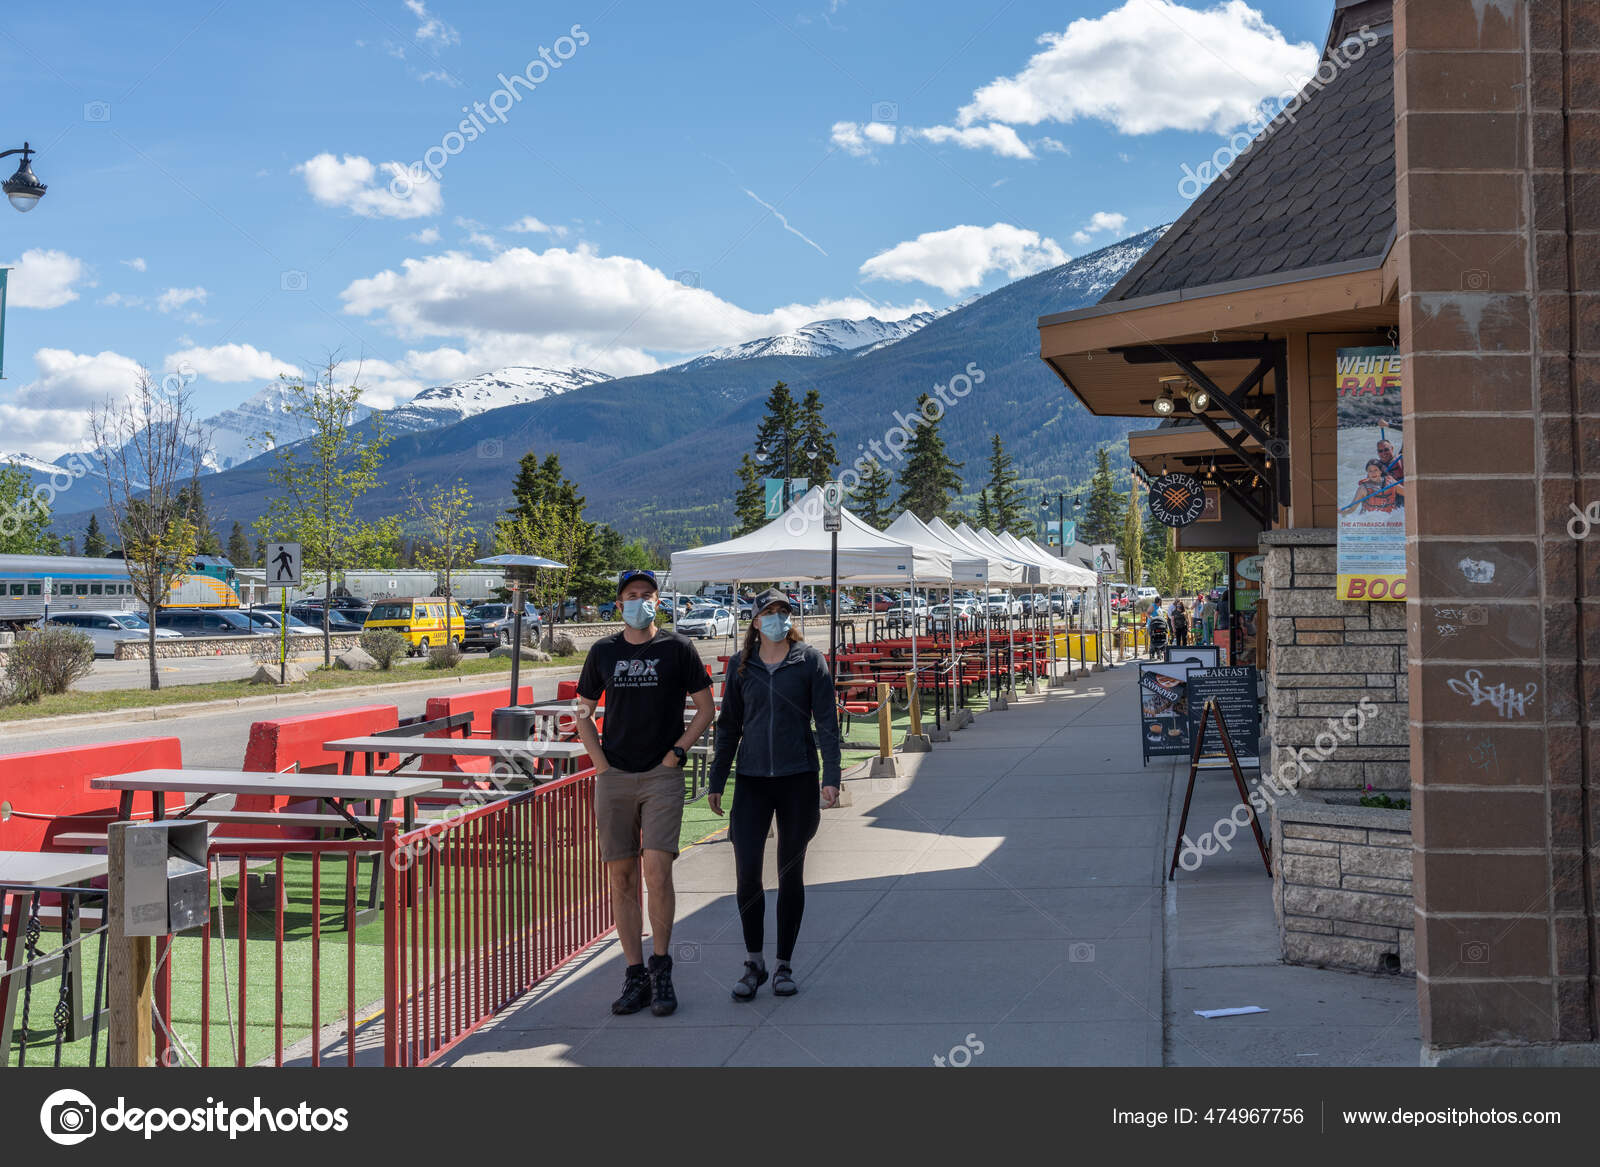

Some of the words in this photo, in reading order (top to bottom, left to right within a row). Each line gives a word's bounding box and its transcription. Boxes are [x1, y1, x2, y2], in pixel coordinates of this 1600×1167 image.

[1337, 354, 1401, 374] WHITE
[830, 488, 836, 499] P
[1153, 473, 1201, 495] JASPER'S
[1152, 498, 1203, 525] WAFFLATO
[613, 658, 660, 677] PDX
